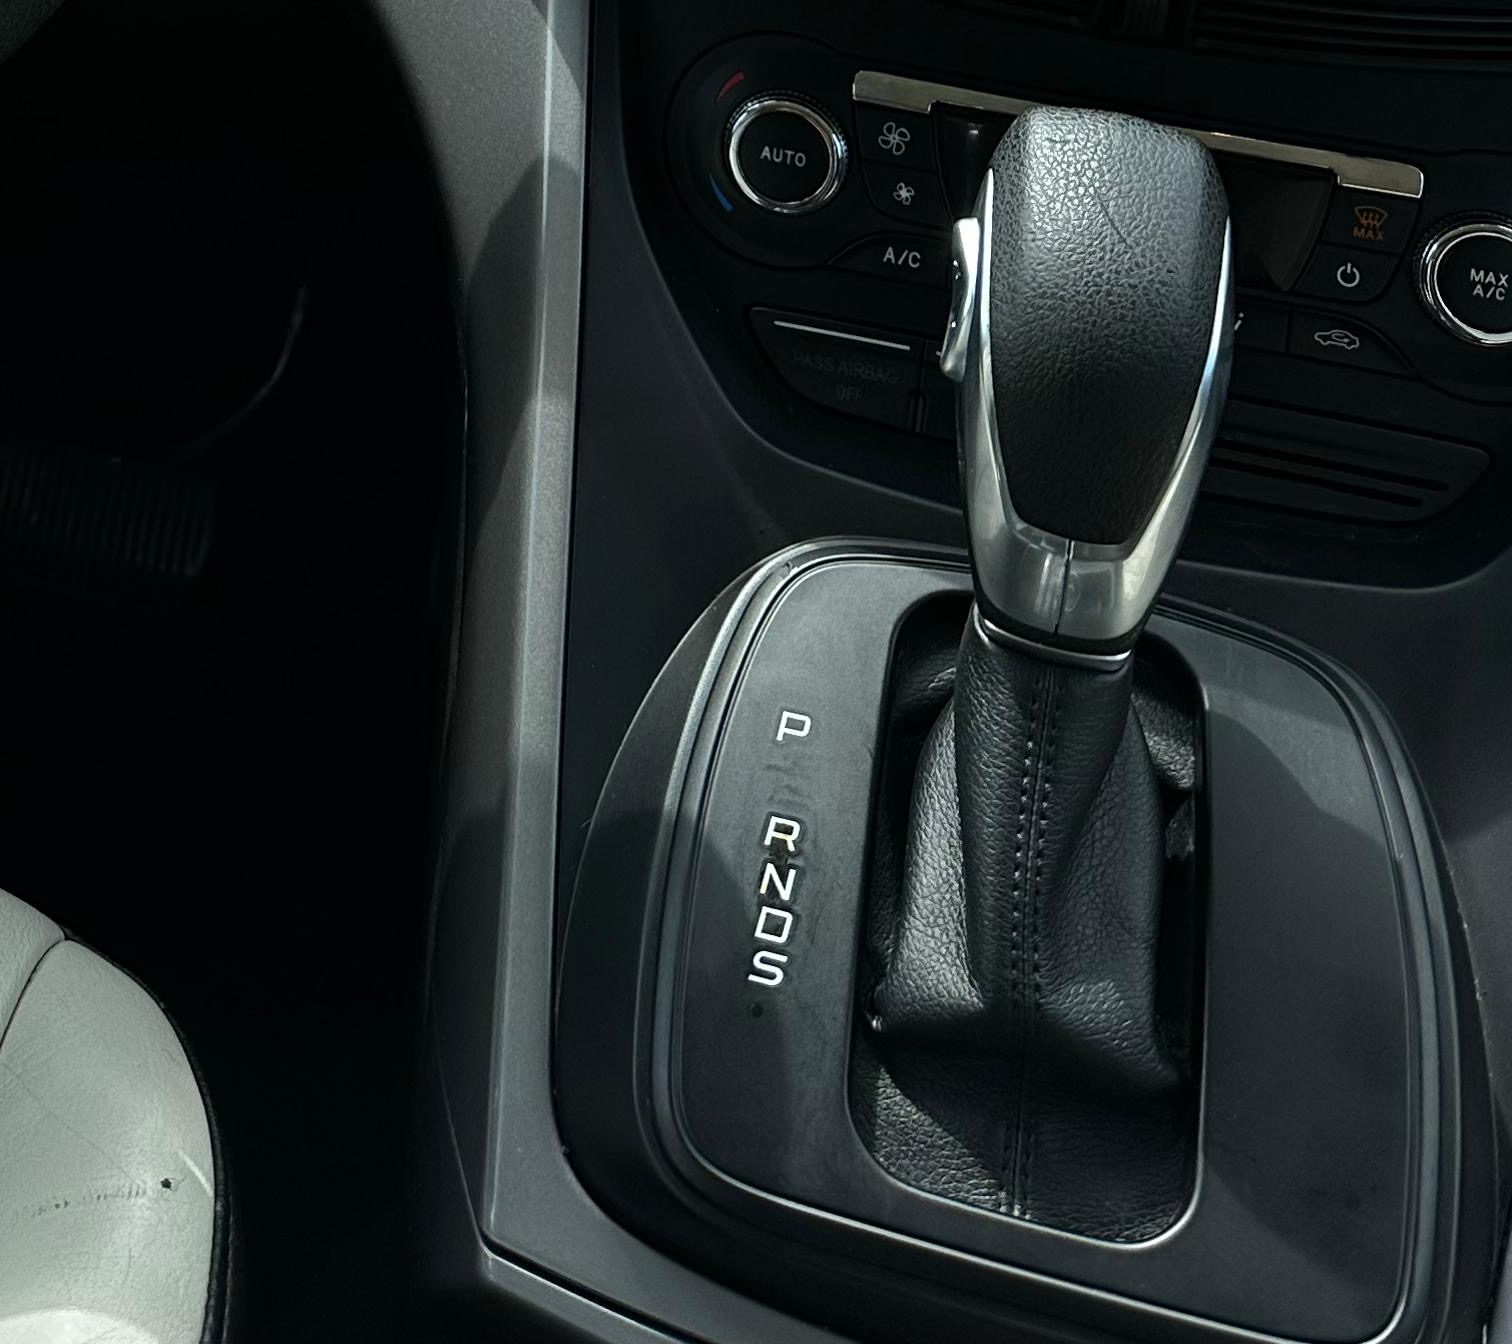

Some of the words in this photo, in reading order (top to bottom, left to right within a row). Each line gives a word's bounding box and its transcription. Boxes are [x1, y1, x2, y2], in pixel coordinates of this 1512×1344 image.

[760, 146, 806, 167] AUTO
[1352, 226, 1384, 241] MAX
[883, 246, 921, 268] A/C
[1470, 268, 1509, 288] MAX
[1472, 284, 1506, 301] A/C
[793, 350, 835, 373] PASS
[838, 359, 899, 384] AIRBAG
[837, 385, 863, 402] OFF
[776, 710, 812, 742] P
[764, 815, 801, 852] R
[759, 862, 797, 901] N
[753, 905, 794, 944] D
[748, 950, 789, 987] S
